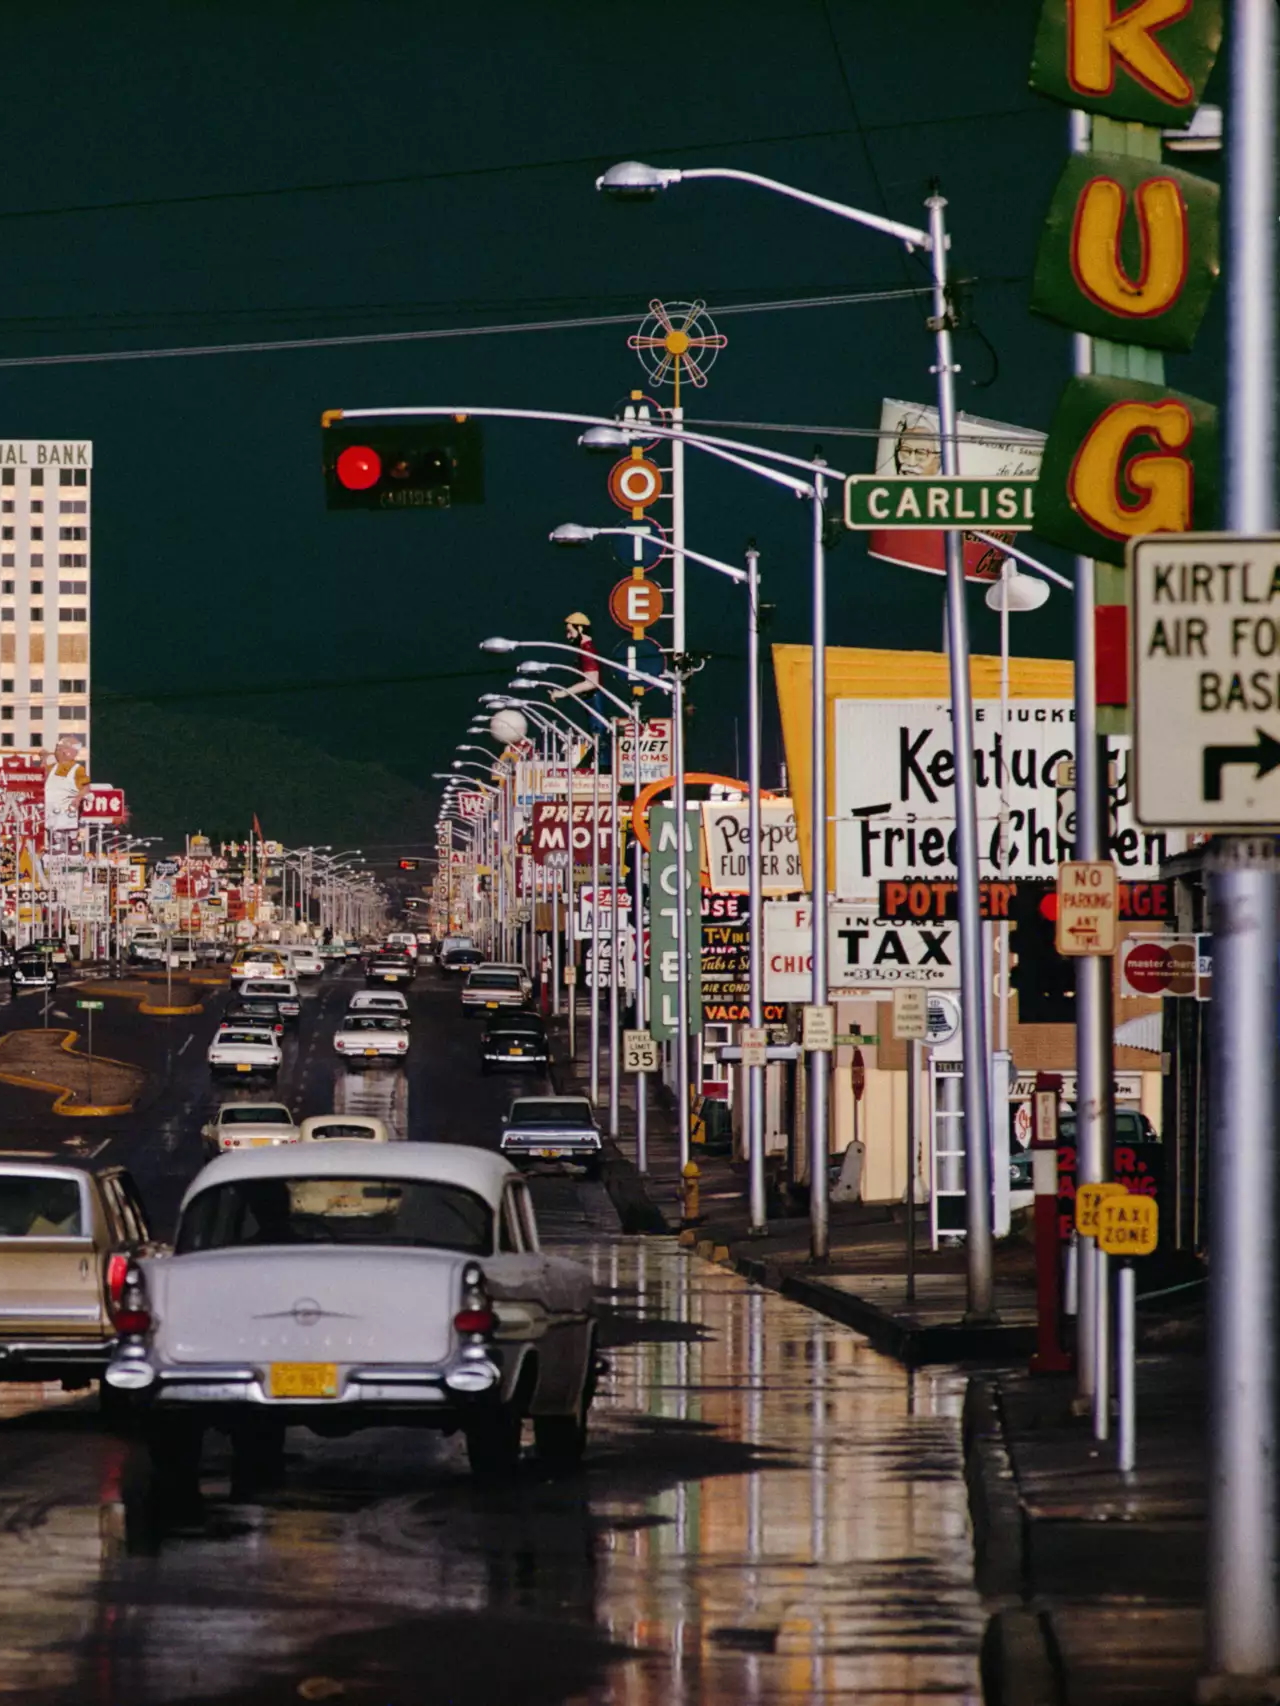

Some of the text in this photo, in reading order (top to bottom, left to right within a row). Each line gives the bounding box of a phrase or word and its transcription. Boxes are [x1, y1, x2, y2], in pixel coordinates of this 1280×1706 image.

[37, 444, 88, 465] BANK
[868, 487, 1034, 518] CARLISL
[1147, 617, 1210, 659] AIR
[1200, 672, 1280, 713] BAS
[946, 709, 985, 721] TE
[621, 741, 668, 752] QUIET
[900, 726, 1128, 806] Kentucy
[538, 827, 620, 848] MOT
[989, 808, 1166, 870] Chiken
[1074, 870, 1103, 887] NO
[885, 882, 1017, 917] POTER'
[1062, 893, 1113, 910] PARKING
[657, 821, 693, 1026] MOTEL
[845, 917, 945, 927] INCOME
[1076, 916, 1099, 927] ANY
[838, 930, 952, 965] TAX
[1074, 935, 1101, 947] TIME
[1128, 960, 1164, 968] master
[854, 968, 933, 980] BLOCK
[702, 983, 719, 993] AIR
[704, 1006, 784, 1020] VACACY
[628, 1052, 654, 1067] 35
[1107, 1206, 1150, 1223] TAXI
[1105, 1227, 1150, 1245] ZONE
